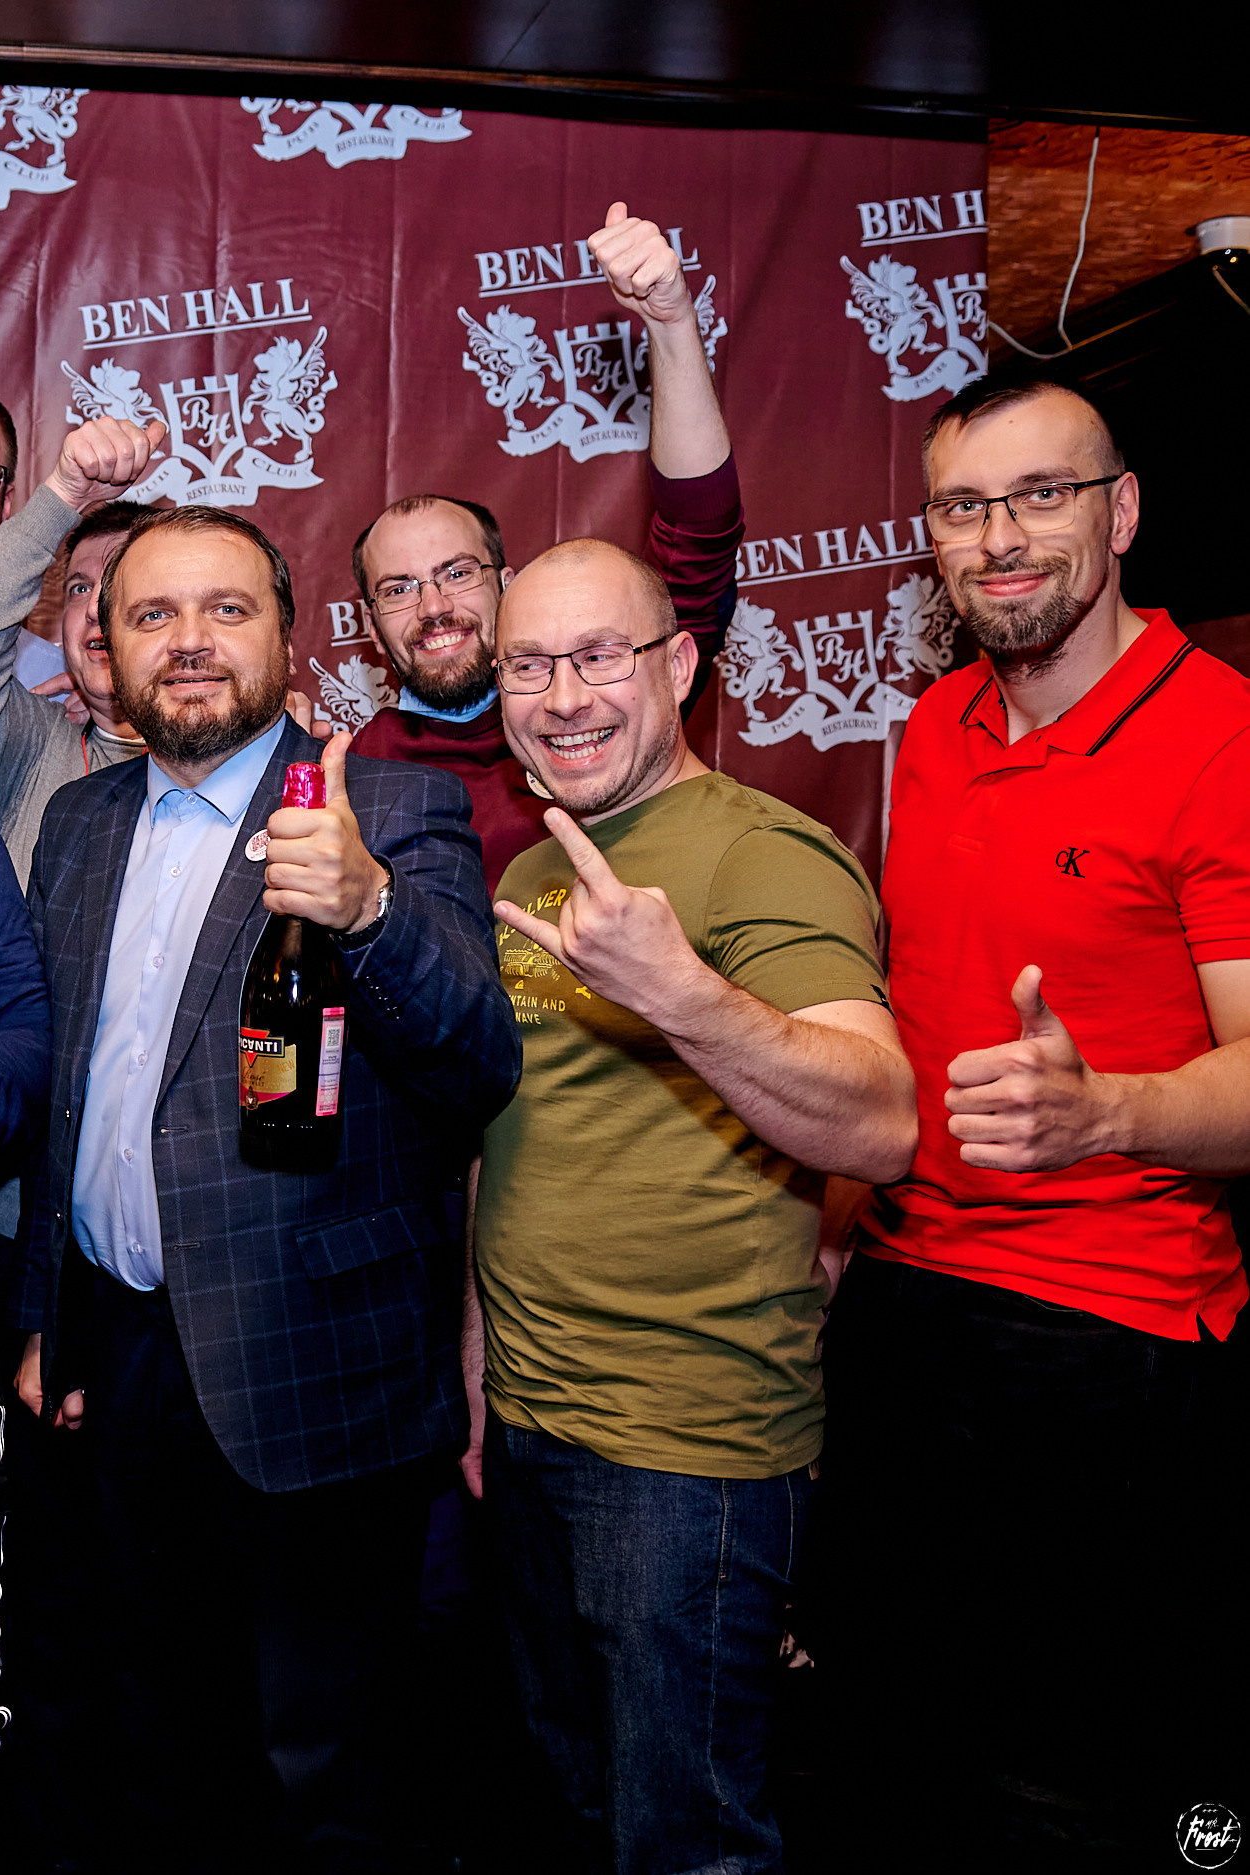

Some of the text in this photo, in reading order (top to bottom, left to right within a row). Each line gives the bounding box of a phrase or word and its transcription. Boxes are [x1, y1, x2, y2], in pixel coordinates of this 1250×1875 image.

[336, 136, 395, 152] RESTAURANT
[856, 195, 944, 240] BEN
[475, 243, 565, 291] BEN
[79, 278, 309, 342] BEN HALL
[580, 429, 639, 447] RESTAURANT
[186, 485, 246, 501] RESTAURANT
[735, 515, 935, 580] BEN HALL
[822, 720, 879, 737] RESTAURANT
[508, 994, 566, 1012] NTAIN AND
